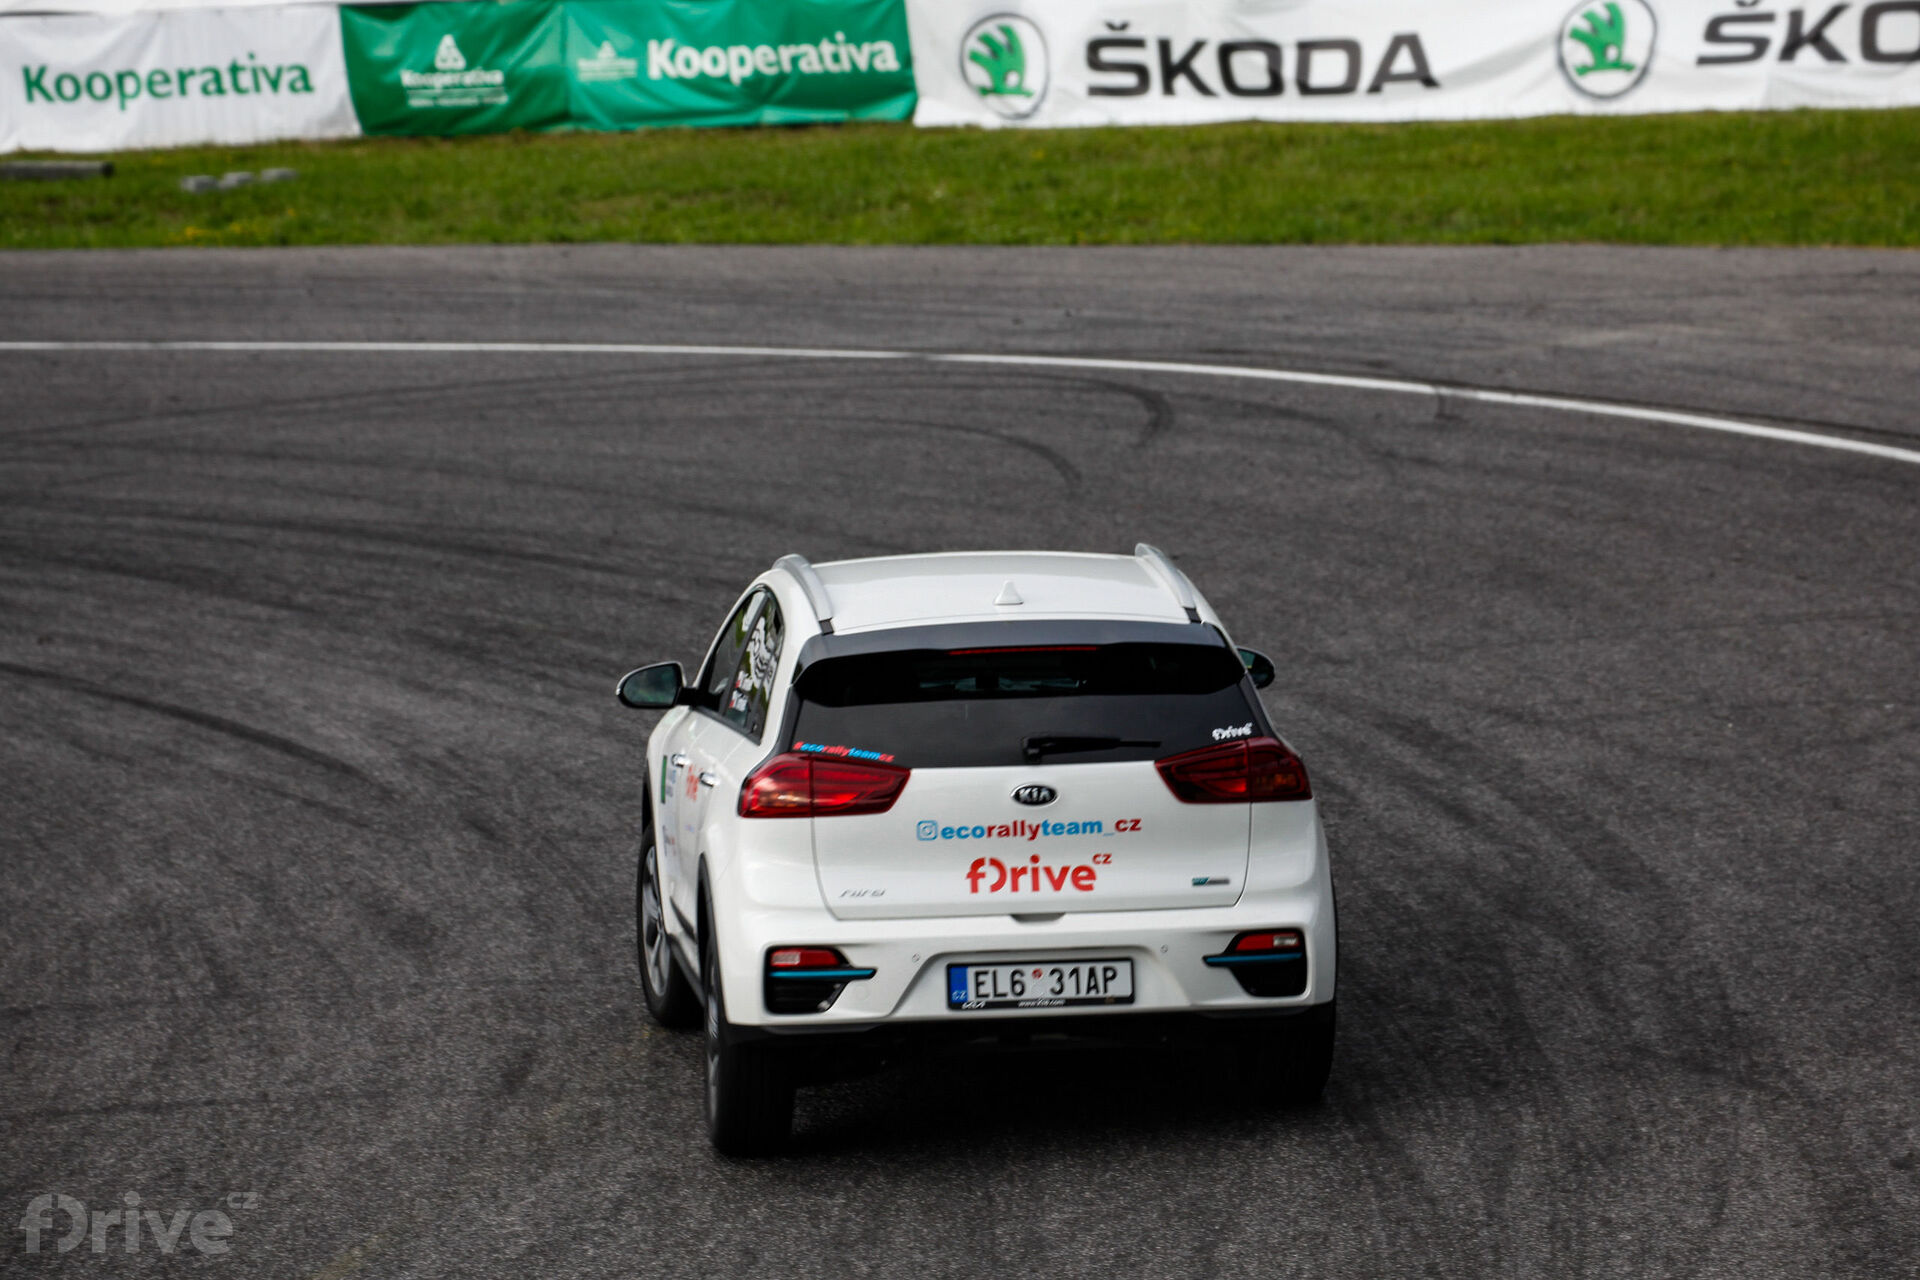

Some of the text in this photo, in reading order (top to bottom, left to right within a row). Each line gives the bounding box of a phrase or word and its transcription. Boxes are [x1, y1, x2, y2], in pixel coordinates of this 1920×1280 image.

[22, 54, 314, 110] Kooperativa
[647, 33, 899, 85] Kooperativa
[1086, 22, 1440, 97] ŠKODA
[1018, 787, 1052, 801] KIA
